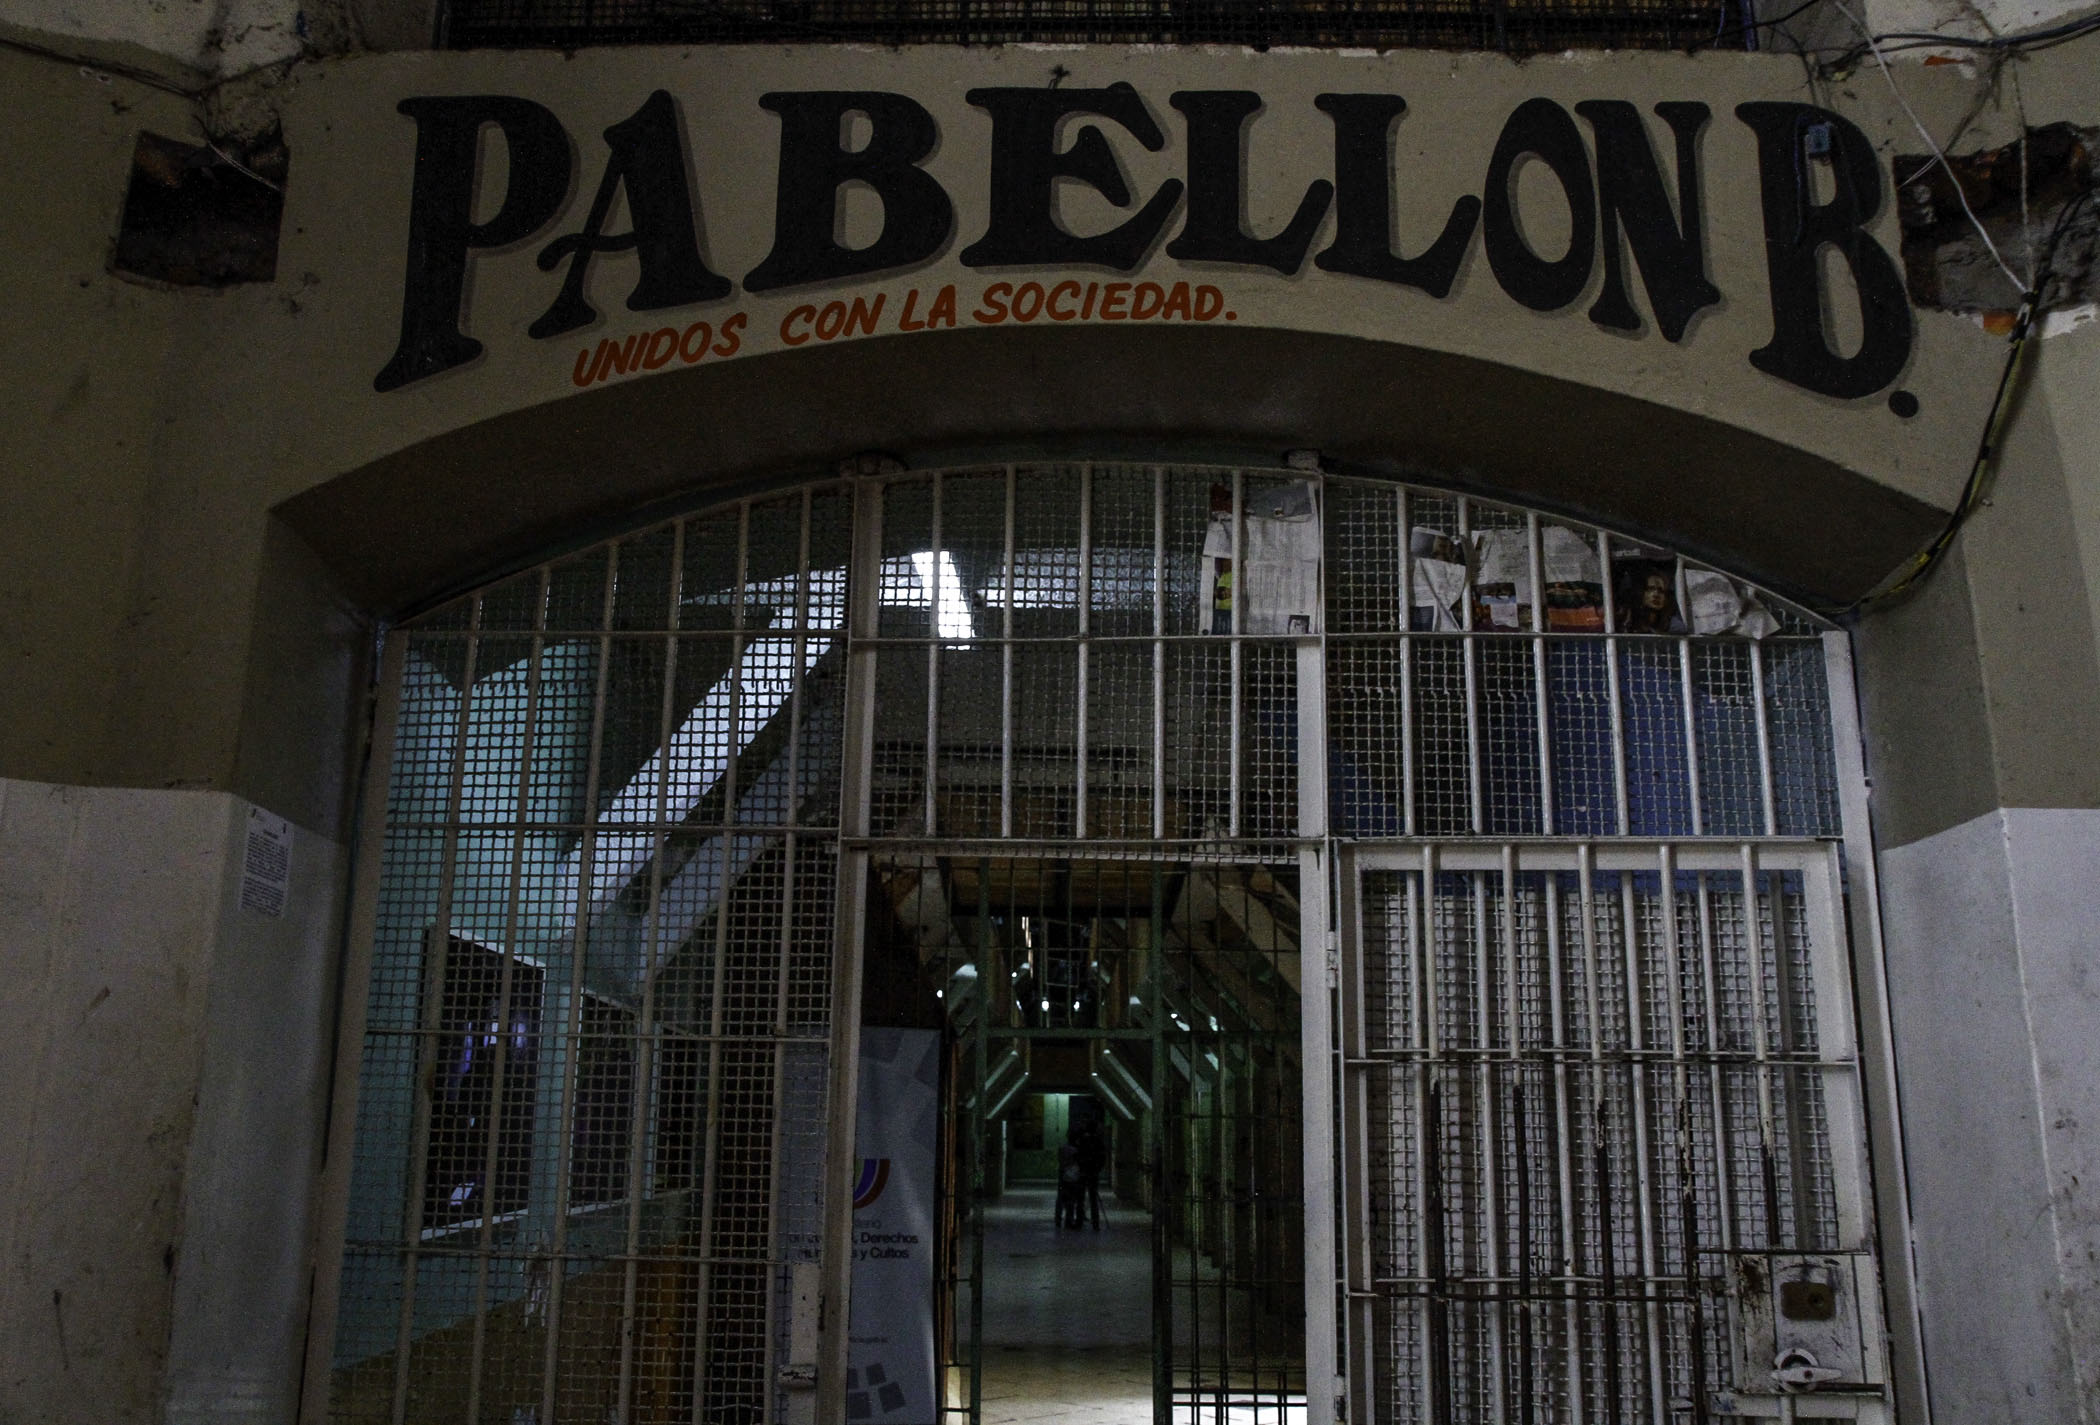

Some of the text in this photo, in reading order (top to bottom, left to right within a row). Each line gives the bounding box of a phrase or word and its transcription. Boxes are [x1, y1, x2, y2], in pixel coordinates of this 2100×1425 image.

[374, 82, 1721, 392] PABELLON
[572, 280, 1237, 387] UNIDOS CON LA SOCIEDAD.
[861, 1232, 918, 1244] Derechos
[870, 1247, 910, 1259] Cultos
